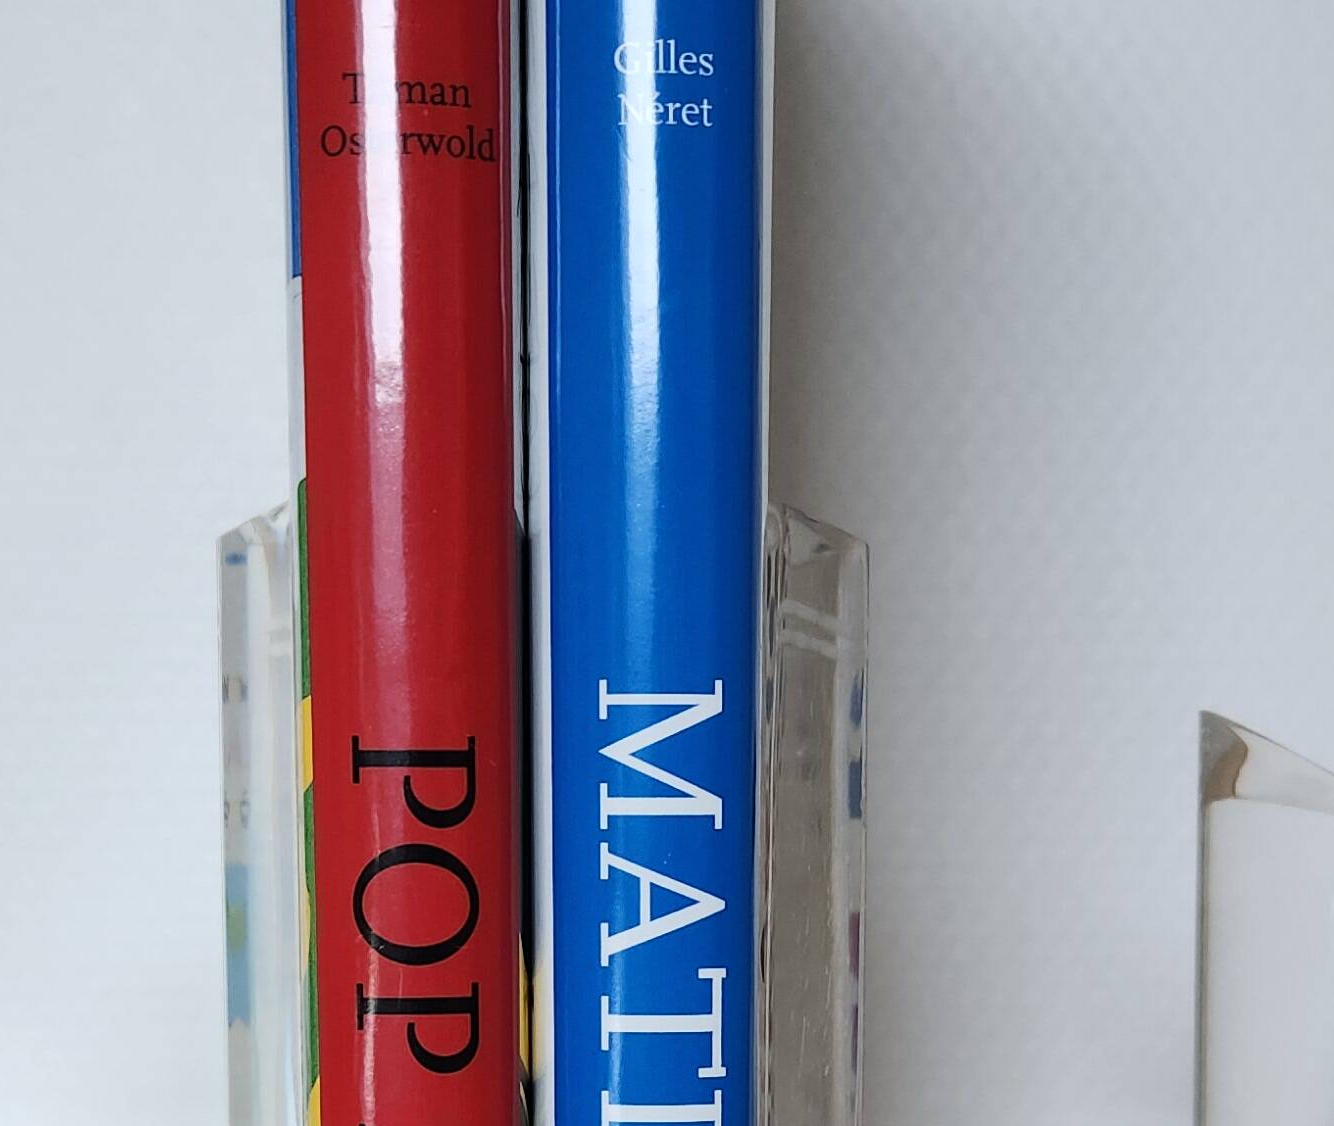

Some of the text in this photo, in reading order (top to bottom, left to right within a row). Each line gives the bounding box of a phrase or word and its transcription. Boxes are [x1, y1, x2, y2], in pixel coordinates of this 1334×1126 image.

[613, 38, 714, 76] Gilles
[342, 72, 472, 108] Tman
[617, 91, 713, 127] Néret
[320, 124, 496, 162] Osrwold
[351, 735, 480, 1074] POP
